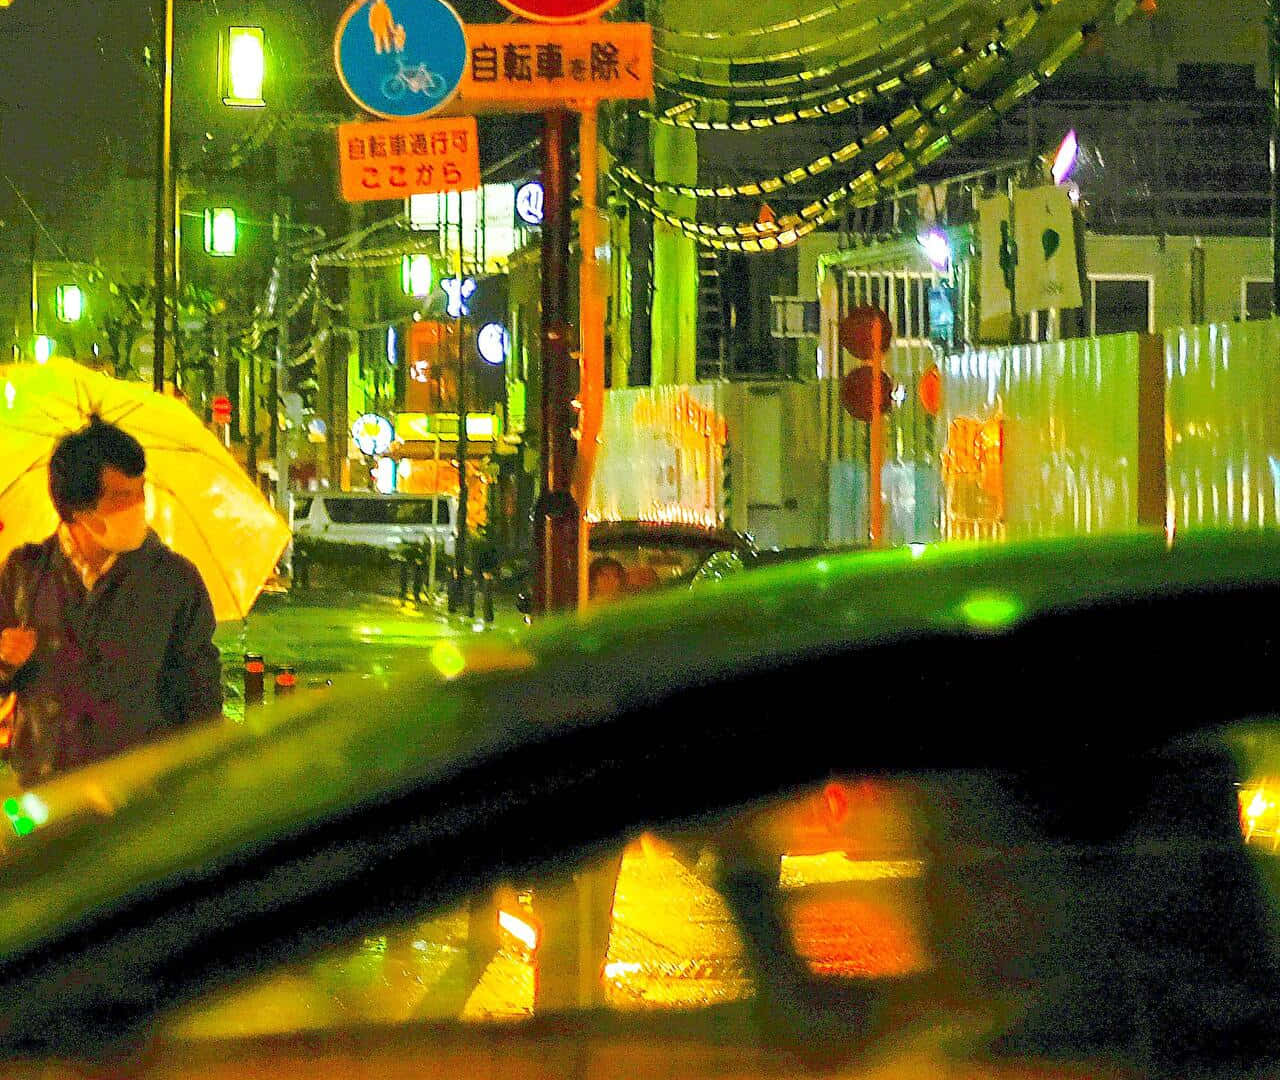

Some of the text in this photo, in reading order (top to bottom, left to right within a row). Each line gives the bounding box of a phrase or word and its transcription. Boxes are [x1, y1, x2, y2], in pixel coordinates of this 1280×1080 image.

[470, 41, 640, 83] 自転車を除く
[347, 129, 470, 160] 自転車通行可
[361, 162, 463, 189] ここから
